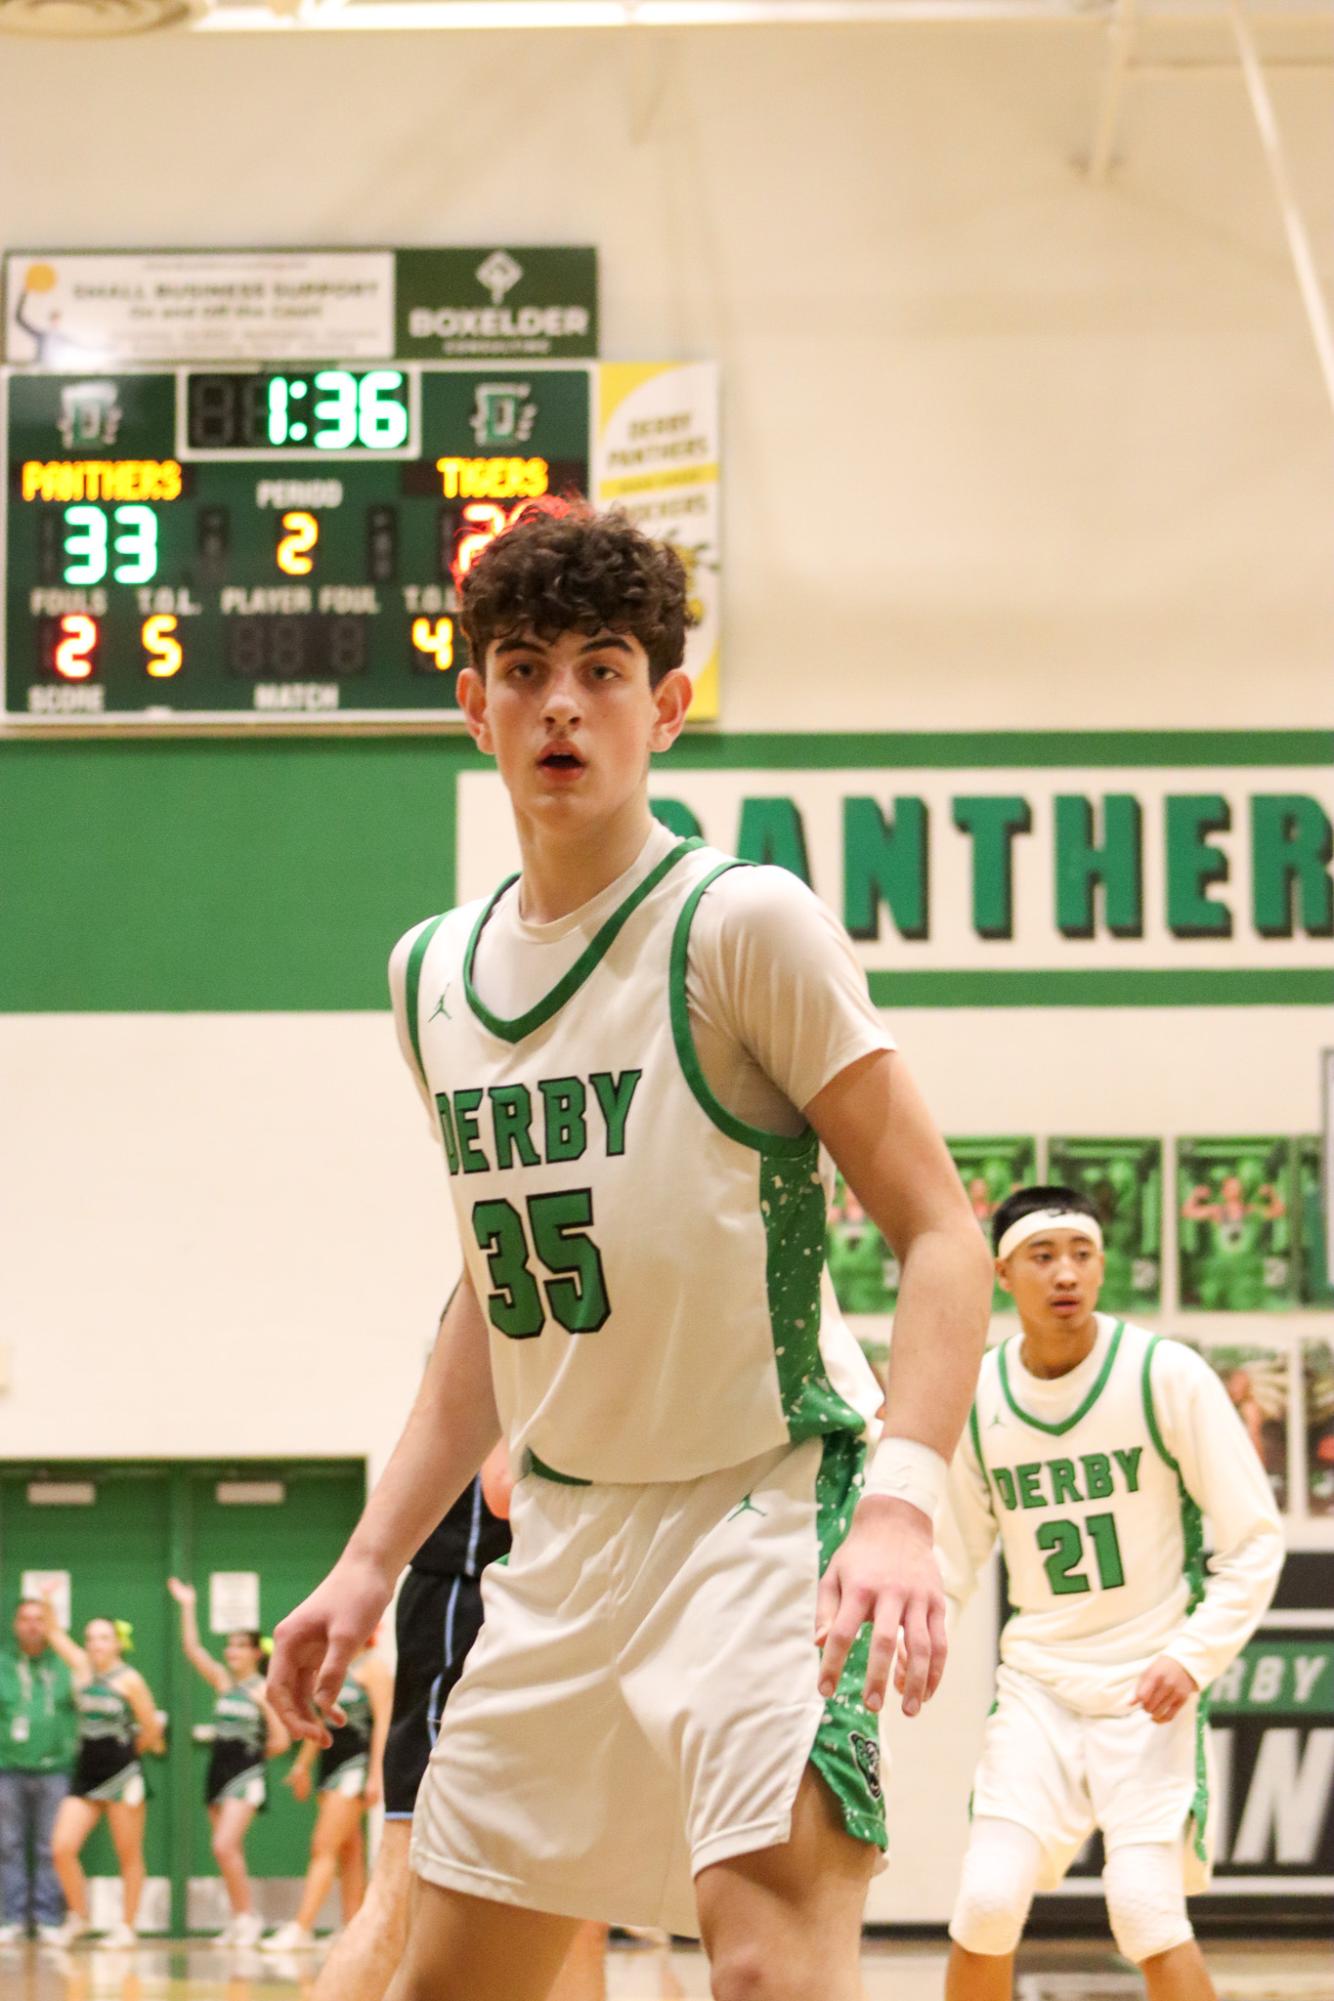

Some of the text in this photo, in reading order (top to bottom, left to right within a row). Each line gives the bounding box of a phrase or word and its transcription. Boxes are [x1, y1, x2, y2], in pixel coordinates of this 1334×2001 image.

[408, 306, 590, 338] BOXELDER
[268, 370, 408, 449] 1:36
[22, 460, 182, 501] PANTHERS
[255, 479, 344, 508] PERIOD
[436, 457, 548, 499] TIGERS
[64, 505, 158, 585] 33
[277, 511, 319, 575] 2
[220, 585, 312, 615] PLAYER
[55, 614, 97, 679] 2
[141, 613, 183, 678] 5
[411, 616, 454, 671] 4
[253, 683, 339, 711] MATCH
[435, 1069, 642, 1176] DERBY
[471, 1187, 612, 1340] 35
[991, 1446, 1143, 1511] DERBY
[1035, 1512, 1126, 1596] 21
